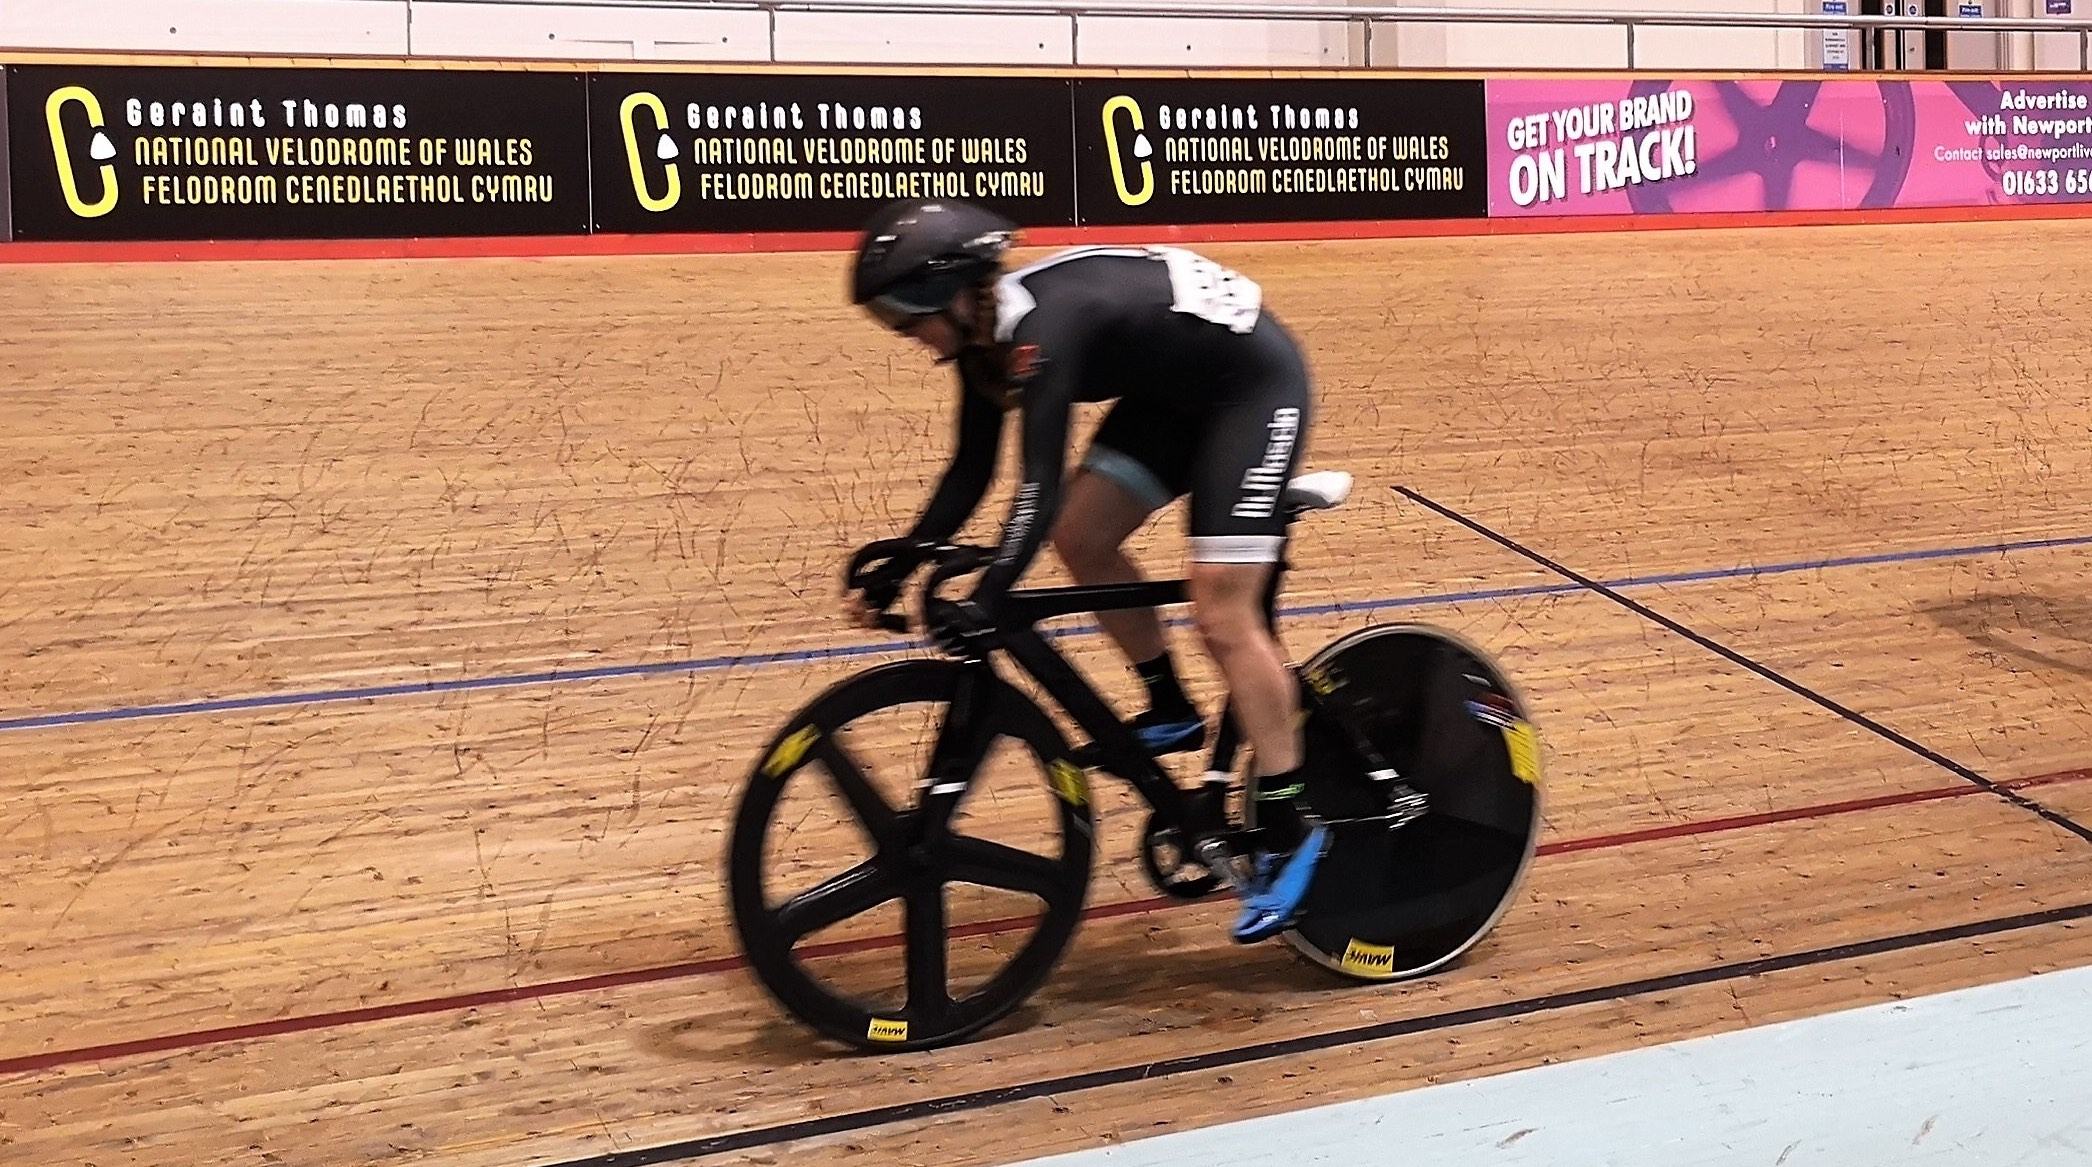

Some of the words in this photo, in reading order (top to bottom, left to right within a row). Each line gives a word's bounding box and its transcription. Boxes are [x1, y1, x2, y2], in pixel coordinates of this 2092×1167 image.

[126, 97, 266, 128] Geraint
[281, 98, 407, 129] Thomas
[2000, 89, 2088, 110] Advertise
[687, 101, 804, 130] Geraint
[817, 102, 922, 130] Thomas
[1159, 103, 1259, 130] Geraint
[1270, 103, 1359, 130] Thomas
[1507, 114, 1549, 151] GET
[1553, 102, 1615, 143] YOUR
[1619, 89, 1693, 131] BRAND
[1964, 114, 2007, 135] with
[134, 136, 259, 166] NATIONAL
[265, 137, 412, 166] VELODROME
[419, 137, 447, 166] OF
[454, 138, 533, 166] WALES
[694, 137, 798, 165] NATIONAL
[803, 137, 926, 164] VELODROME
[931, 137, 955, 164] OF
[961, 137, 1027, 164] WALES
[1165, 136, 1254, 163] NATIONAL
[1257, 136, 1362, 162] VELODROME
[1367, 136, 1387, 161] OF
[1392, 135, 1449, 161] WALES
[1934, 146, 1983, 161] Contact
[1509, 148, 1566, 206] ON
[1574, 124, 1697, 194] TRACK!
[143, 175, 277, 205] FELODROM
[285, 174, 465, 204] CENEDLAETHOL
[471, 174, 553, 203] CYMRU
[700, 172, 813, 200] FELODROM
[820, 171, 970, 199] CENEDLAETHOL
[975, 171, 1044, 198] CYMRU
[1171, 168, 1267, 195] FELODROM
[1272, 167, 1400, 194] CENEDLAETHOL
[1404, 166, 1464, 192] CYMRU
[2002, 169, 2059, 196] 01633
